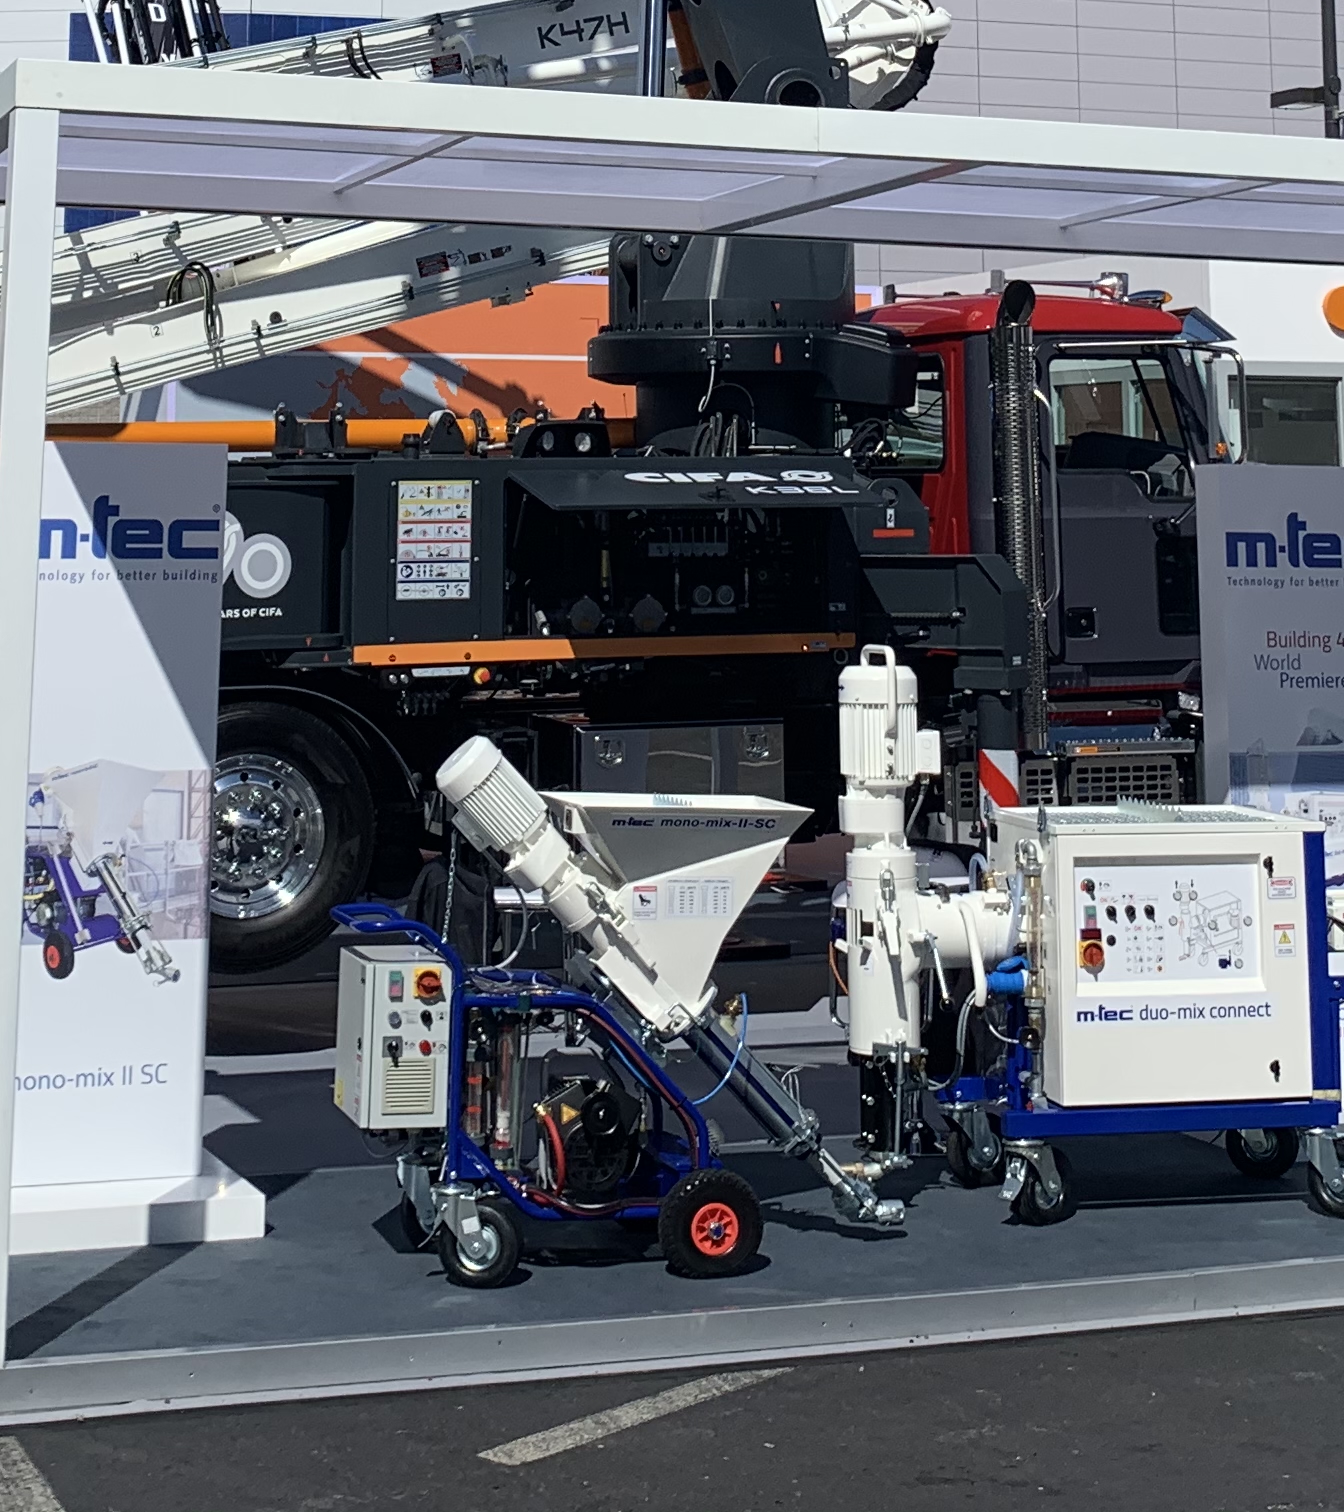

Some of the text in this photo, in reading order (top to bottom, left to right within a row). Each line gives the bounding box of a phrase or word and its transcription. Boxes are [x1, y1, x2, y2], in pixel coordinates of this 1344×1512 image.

[537, 11, 631, 49] K47H
[624, 471, 779, 483] CIFA
[39, 569, 218, 584] nology for better building
[1227, 576, 1285, 589] Technology
[1289, 576, 1305, 587] for
[1308, 577, 1339, 587] better
[221, 607, 283, 618] ARS OF CIFA
[1266, 631, 1332, 653] Building
[1254, 653, 1301, 671] World
[660, 816, 776, 829] mono-mix-II-SC
[1077, 1002, 1271, 1022] m-tec duo-mix connect
[122, 1065, 133, 1085] II
[141, 1063, 169, 1085] SC
